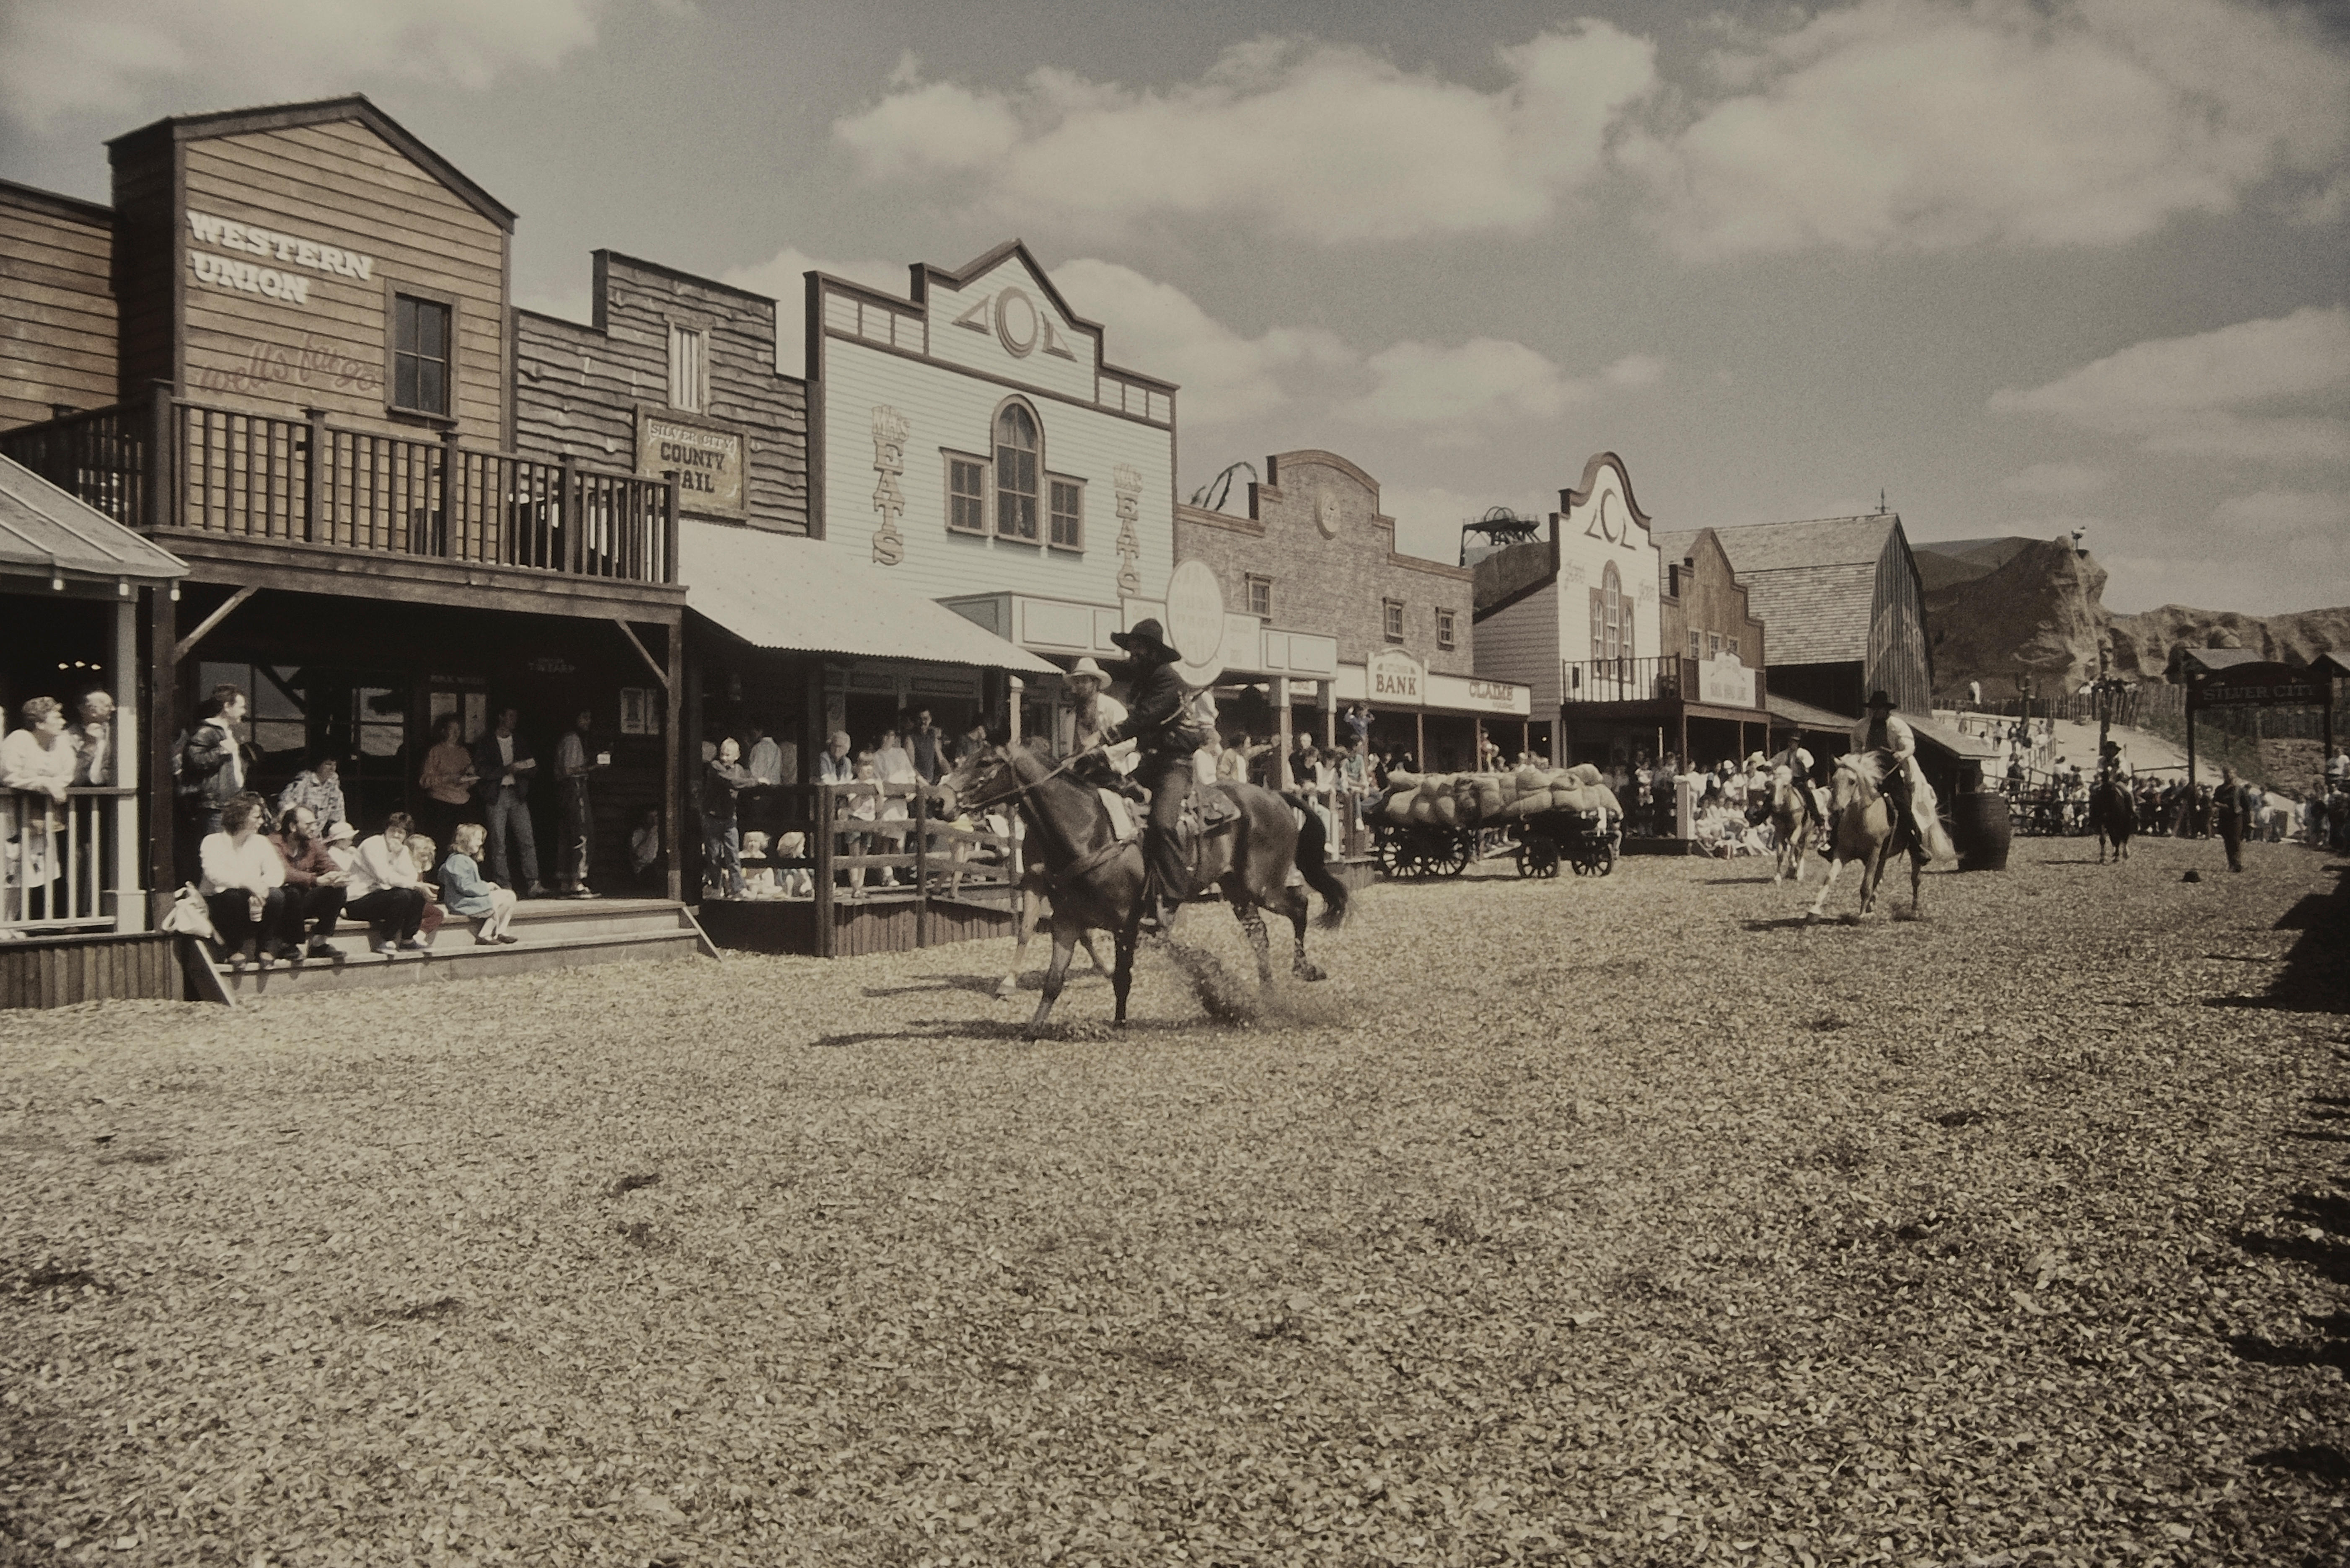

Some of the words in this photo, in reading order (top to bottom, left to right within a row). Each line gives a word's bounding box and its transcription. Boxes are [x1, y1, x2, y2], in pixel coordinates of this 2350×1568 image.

[186, 211, 373, 280] WESTERN
[192, 253, 309, 304] UNION
[651, 425, 698, 445] SILVER
[703, 435, 733, 451] CITY
[660, 442, 725, 470] COUNTY
[675, 468, 715, 493] AIL
[872, 436, 905, 566] EATS
[1115, 490, 1141, 599] EATS
[1376, 674, 1416, 695] BANK
[2202, 687, 2269, 701] SILVER
